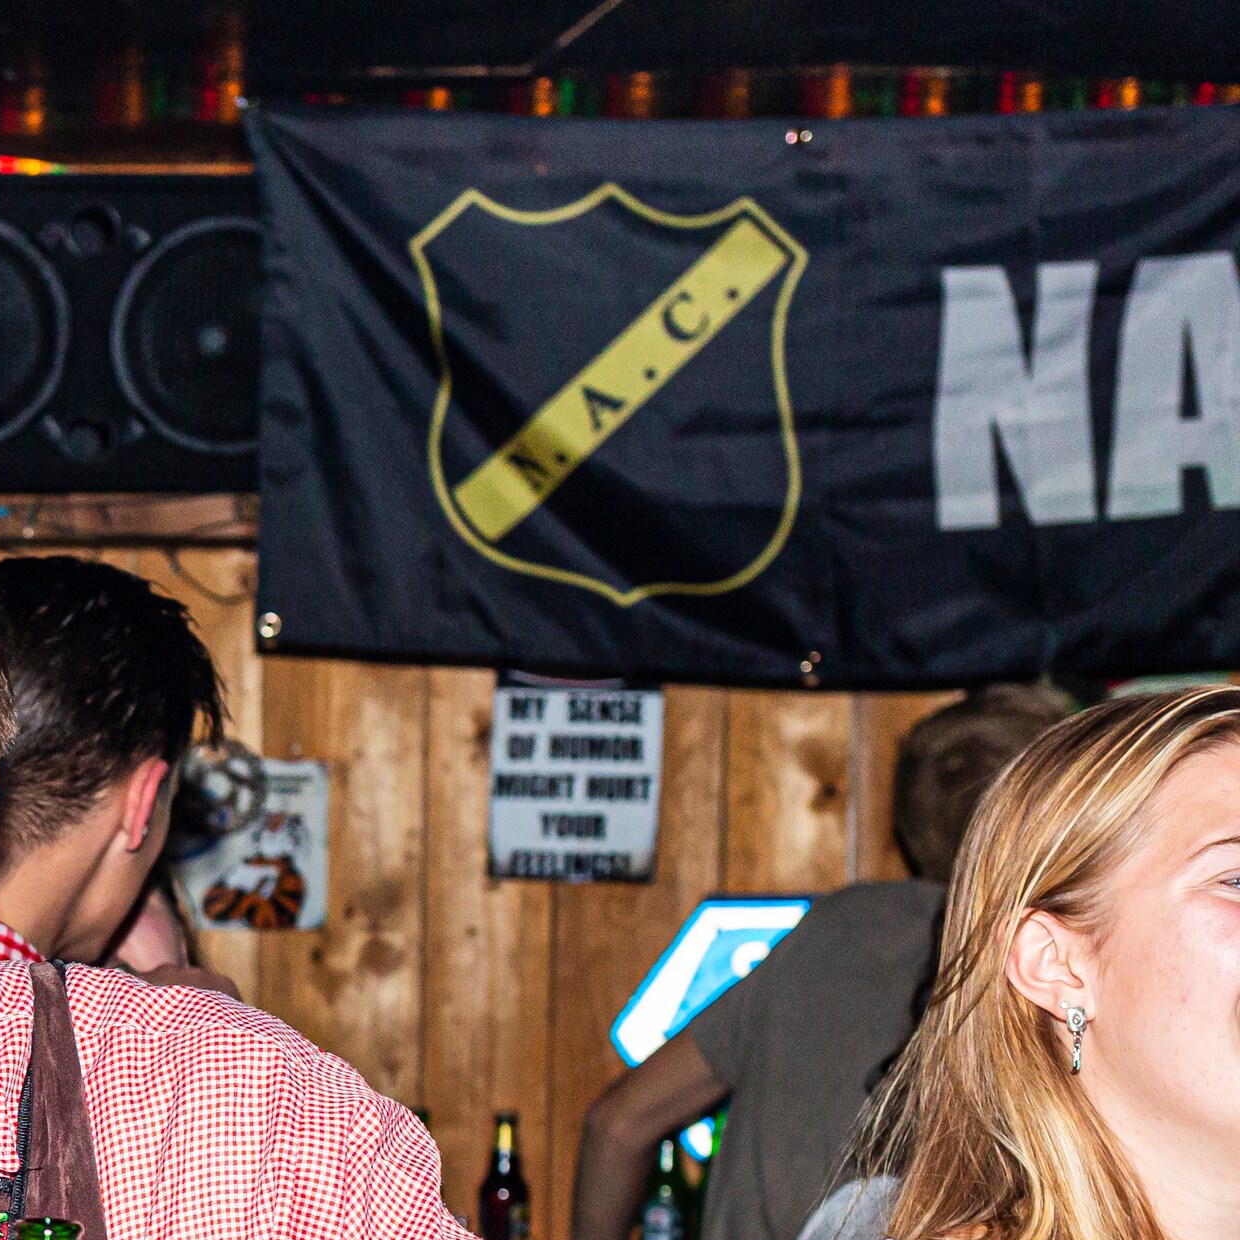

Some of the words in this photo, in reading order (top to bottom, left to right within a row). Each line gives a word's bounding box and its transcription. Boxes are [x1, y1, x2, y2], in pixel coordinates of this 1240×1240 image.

[936, 252, 1240, 530] NA
[510, 697, 544, 721] MY
[568, 697, 642, 723] SENSE
[508, 735, 536, 760] OF
[550, 735, 642, 761] HUMOR
[495, 773, 574, 798] MIGHT
[587, 774, 651, 800] HURT
[540, 812, 607, 839] YOUR
